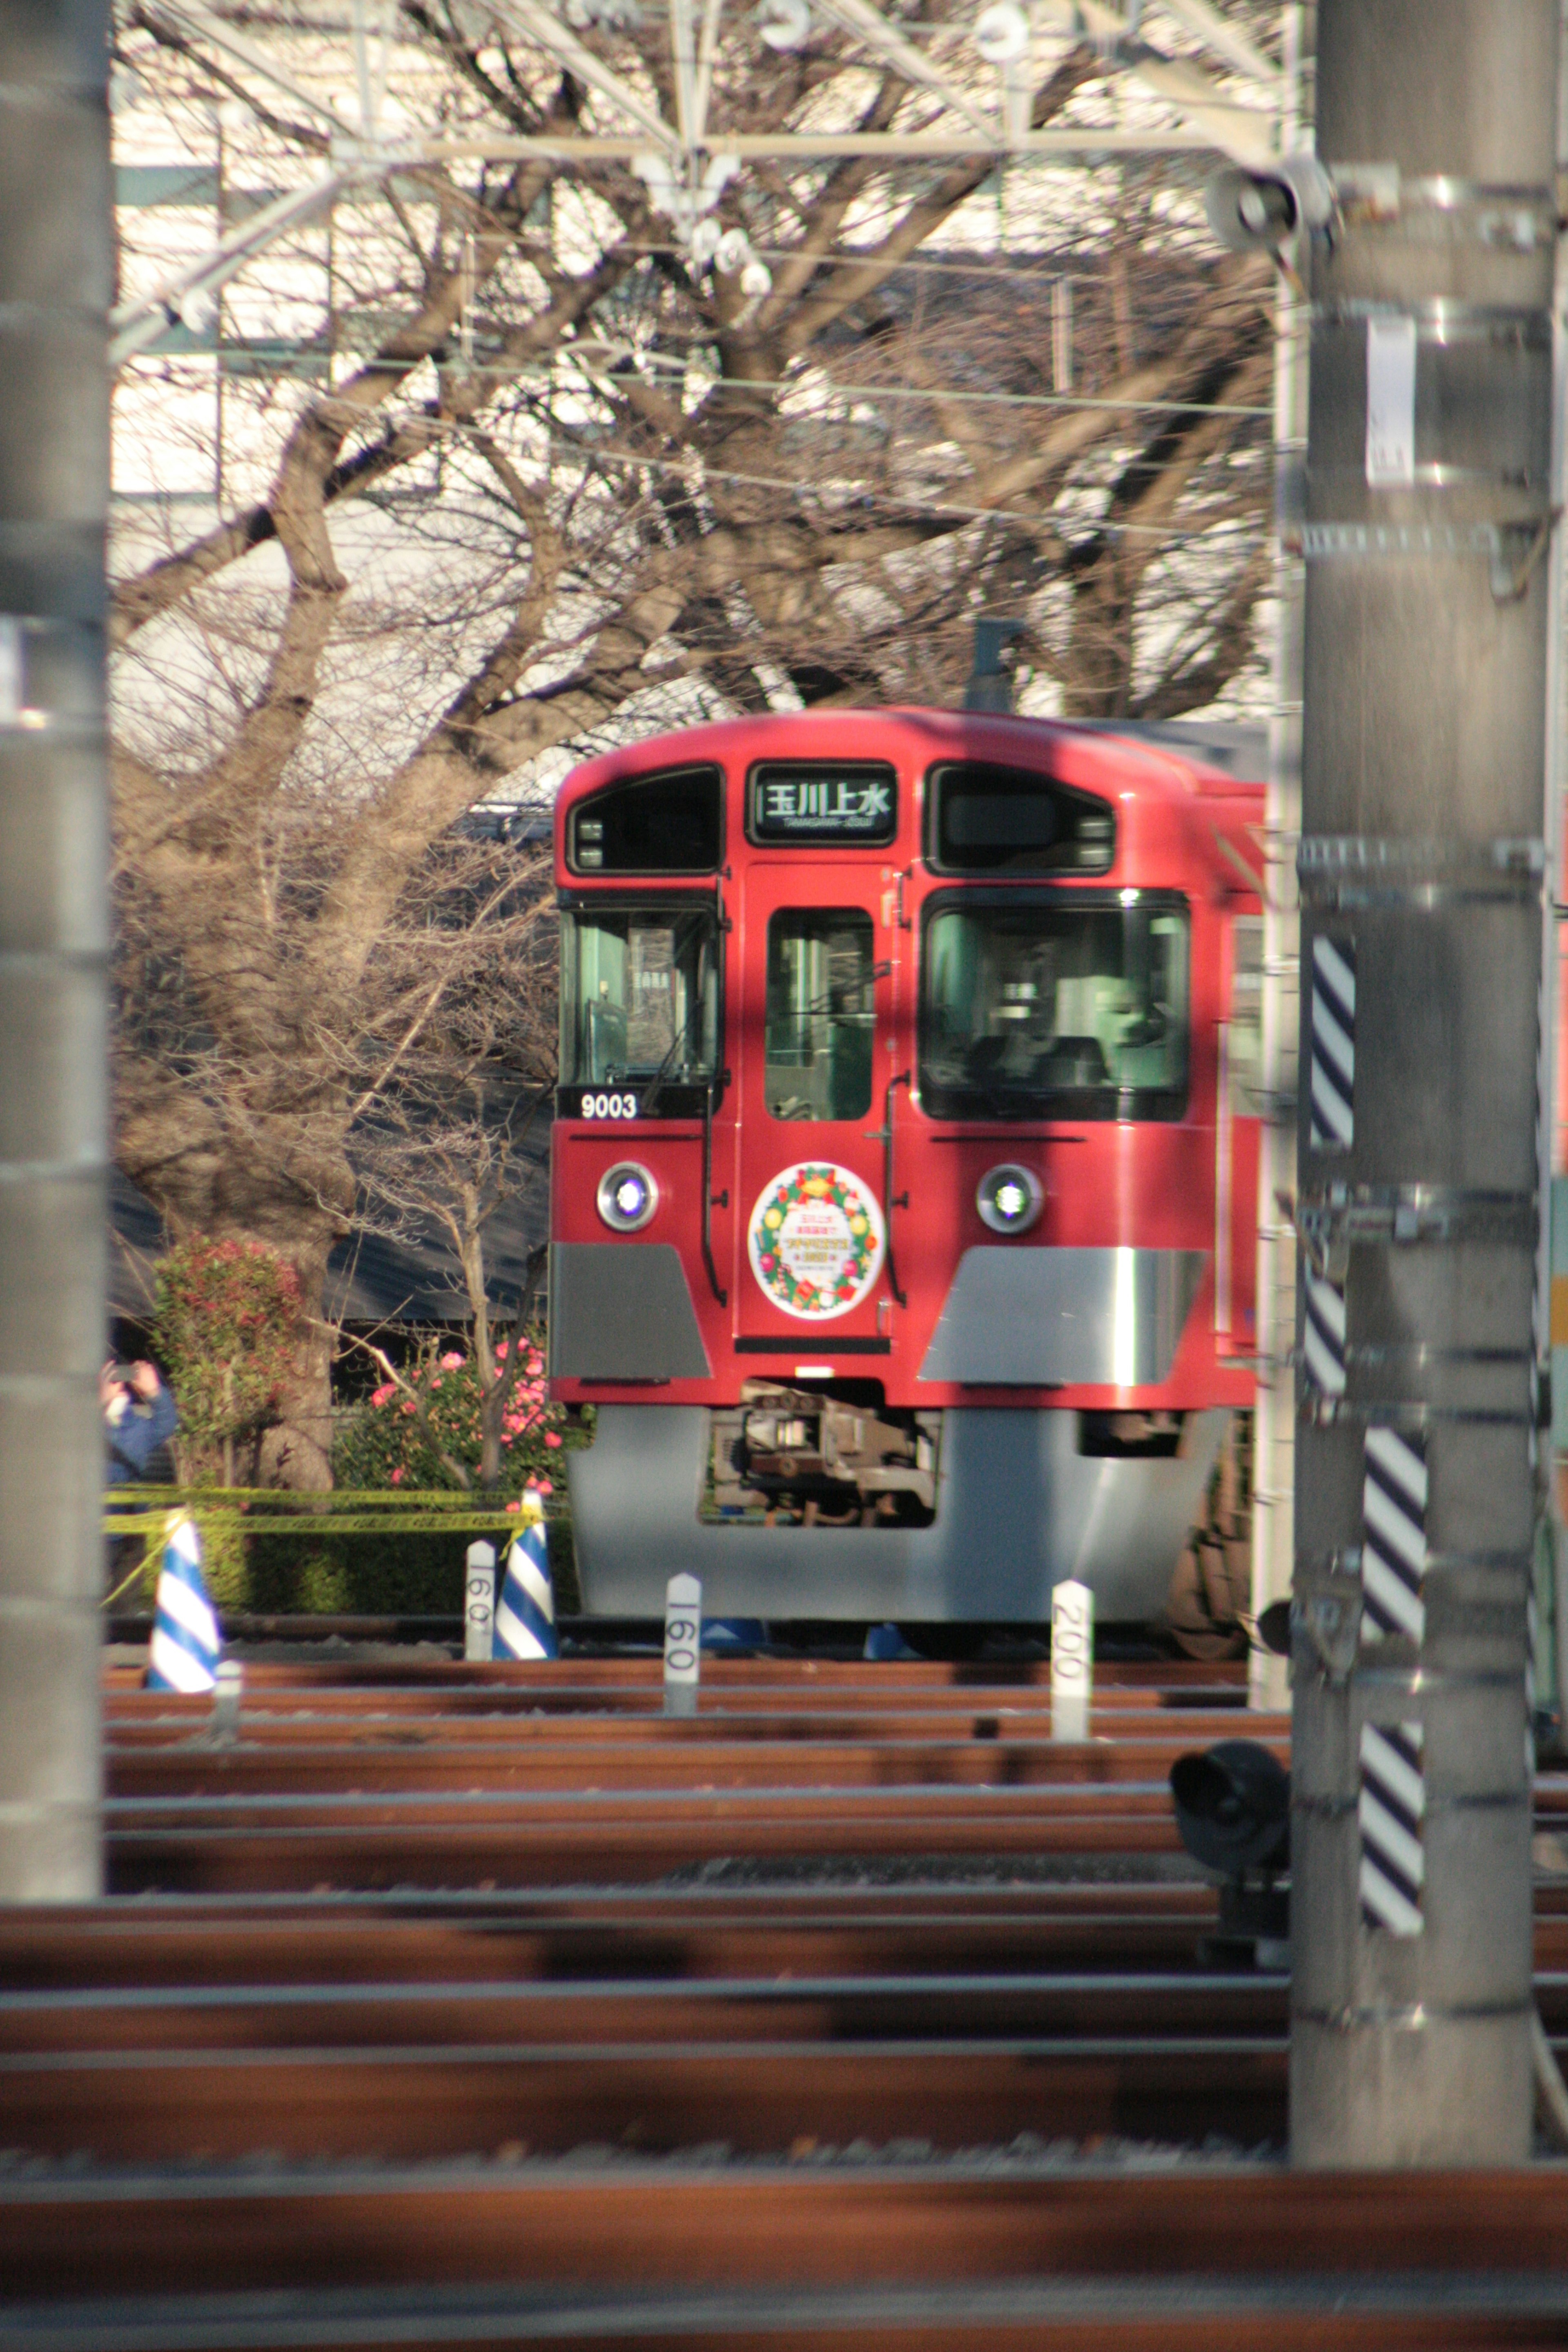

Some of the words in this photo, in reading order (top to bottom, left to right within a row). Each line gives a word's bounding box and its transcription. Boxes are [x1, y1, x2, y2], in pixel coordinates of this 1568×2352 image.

[766, 782, 891, 816] 玉川上水
[581, 1094, 637, 1118] 9003
[469, 1565, 494, 1622] 160
[668, 1603, 697, 1670] 160
[1053, 1602, 1091, 1680] 200
